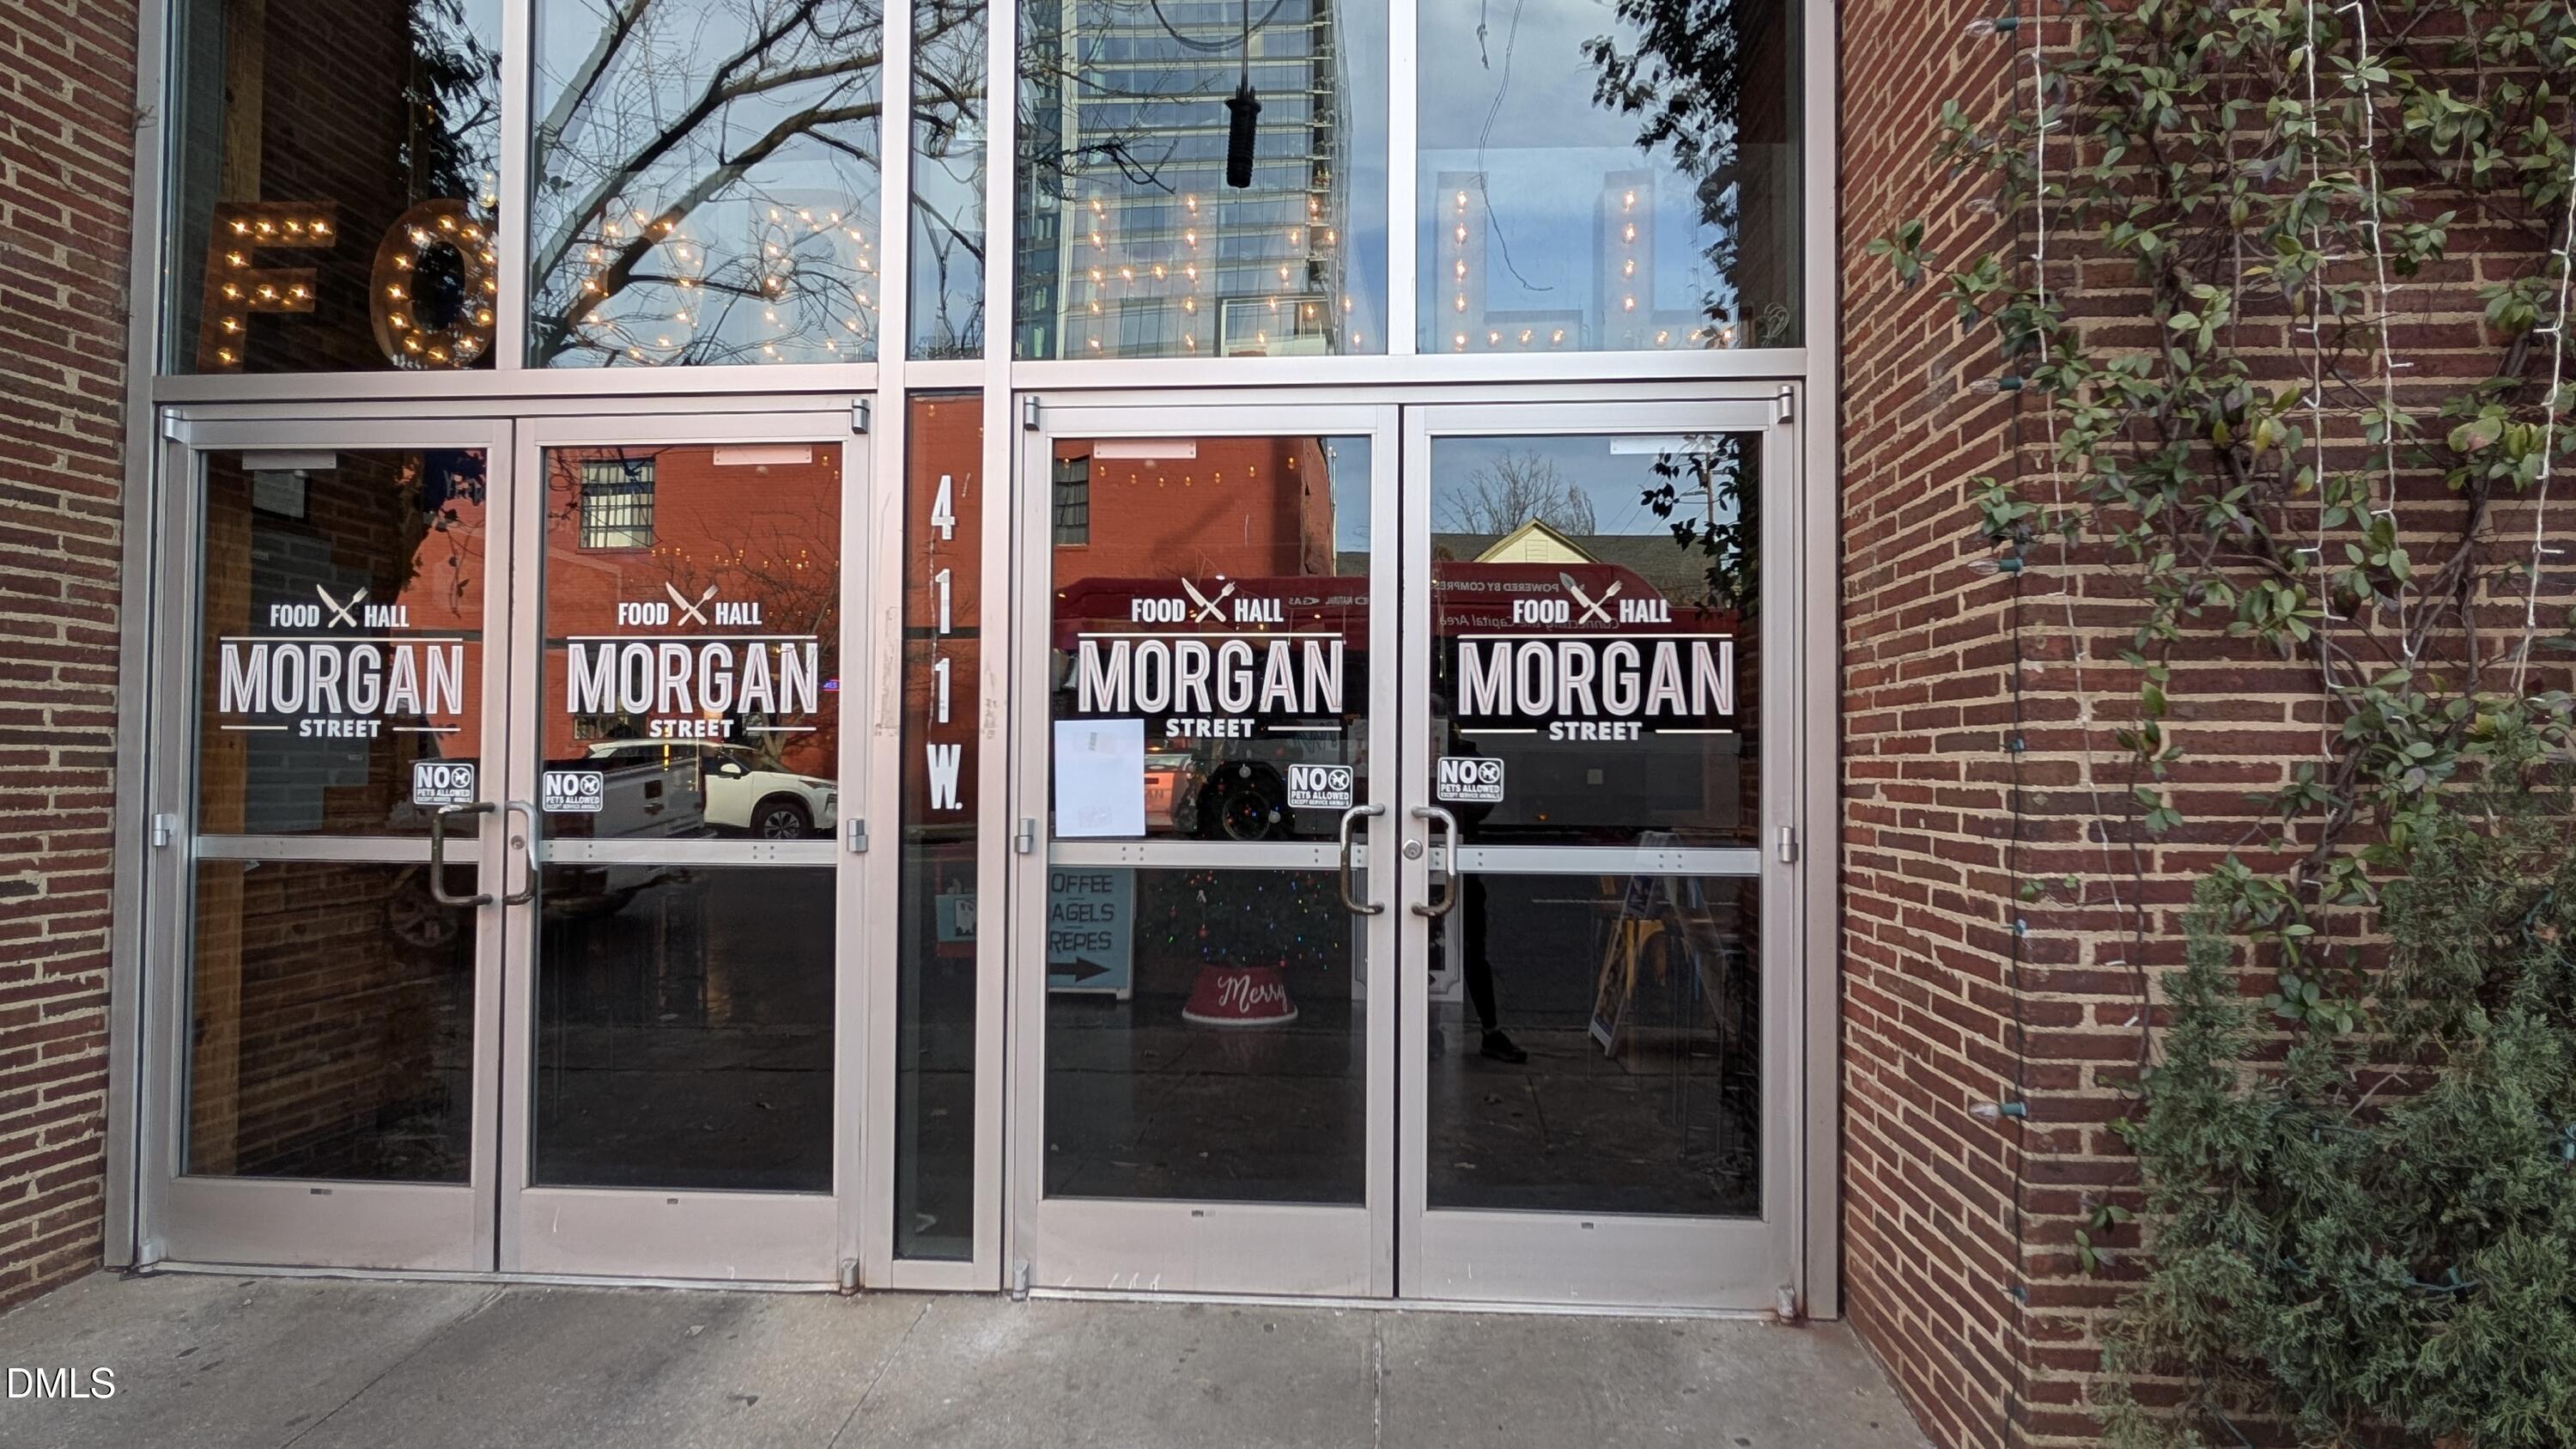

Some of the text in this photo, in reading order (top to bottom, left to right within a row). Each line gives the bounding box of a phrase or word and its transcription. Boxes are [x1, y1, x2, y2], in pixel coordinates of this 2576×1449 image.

[270, 604, 410, 628] FOOD HALL
[618, 602, 762, 625] FOOD HALL
[1132, 598, 1285, 622] FOOD HALL
[1513, 599, 1673, 624] FOOD HALL
[926, 475, 963, 810] 411 W.
[220, 643, 464, 715] MORGAN
[567, 642, 818, 715] MORGAN
[1078, 639, 1344, 714] MORGAN
[1458, 641, 1735, 716] MORGAN
[300, 719, 382, 738] STREET
[649, 719, 734, 738] STREET
[1165, 718, 1255, 738] STREET
[1548, 721, 1643, 741] STREET
[417, 766, 450, 788] NO
[1291, 767, 1327, 791] NO
[1441, 760, 1477, 784] NO
[546, 774, 580, 796] NO
[1312, 791, 1350, 801] ALLOWED
[1050, 873, 1114, 893] OFFEE
[1051, 904, 1115, 923] AGELS
[1049, 931, 1113, 953] REPES
[1218, 974, 1288, 1014] Merry
